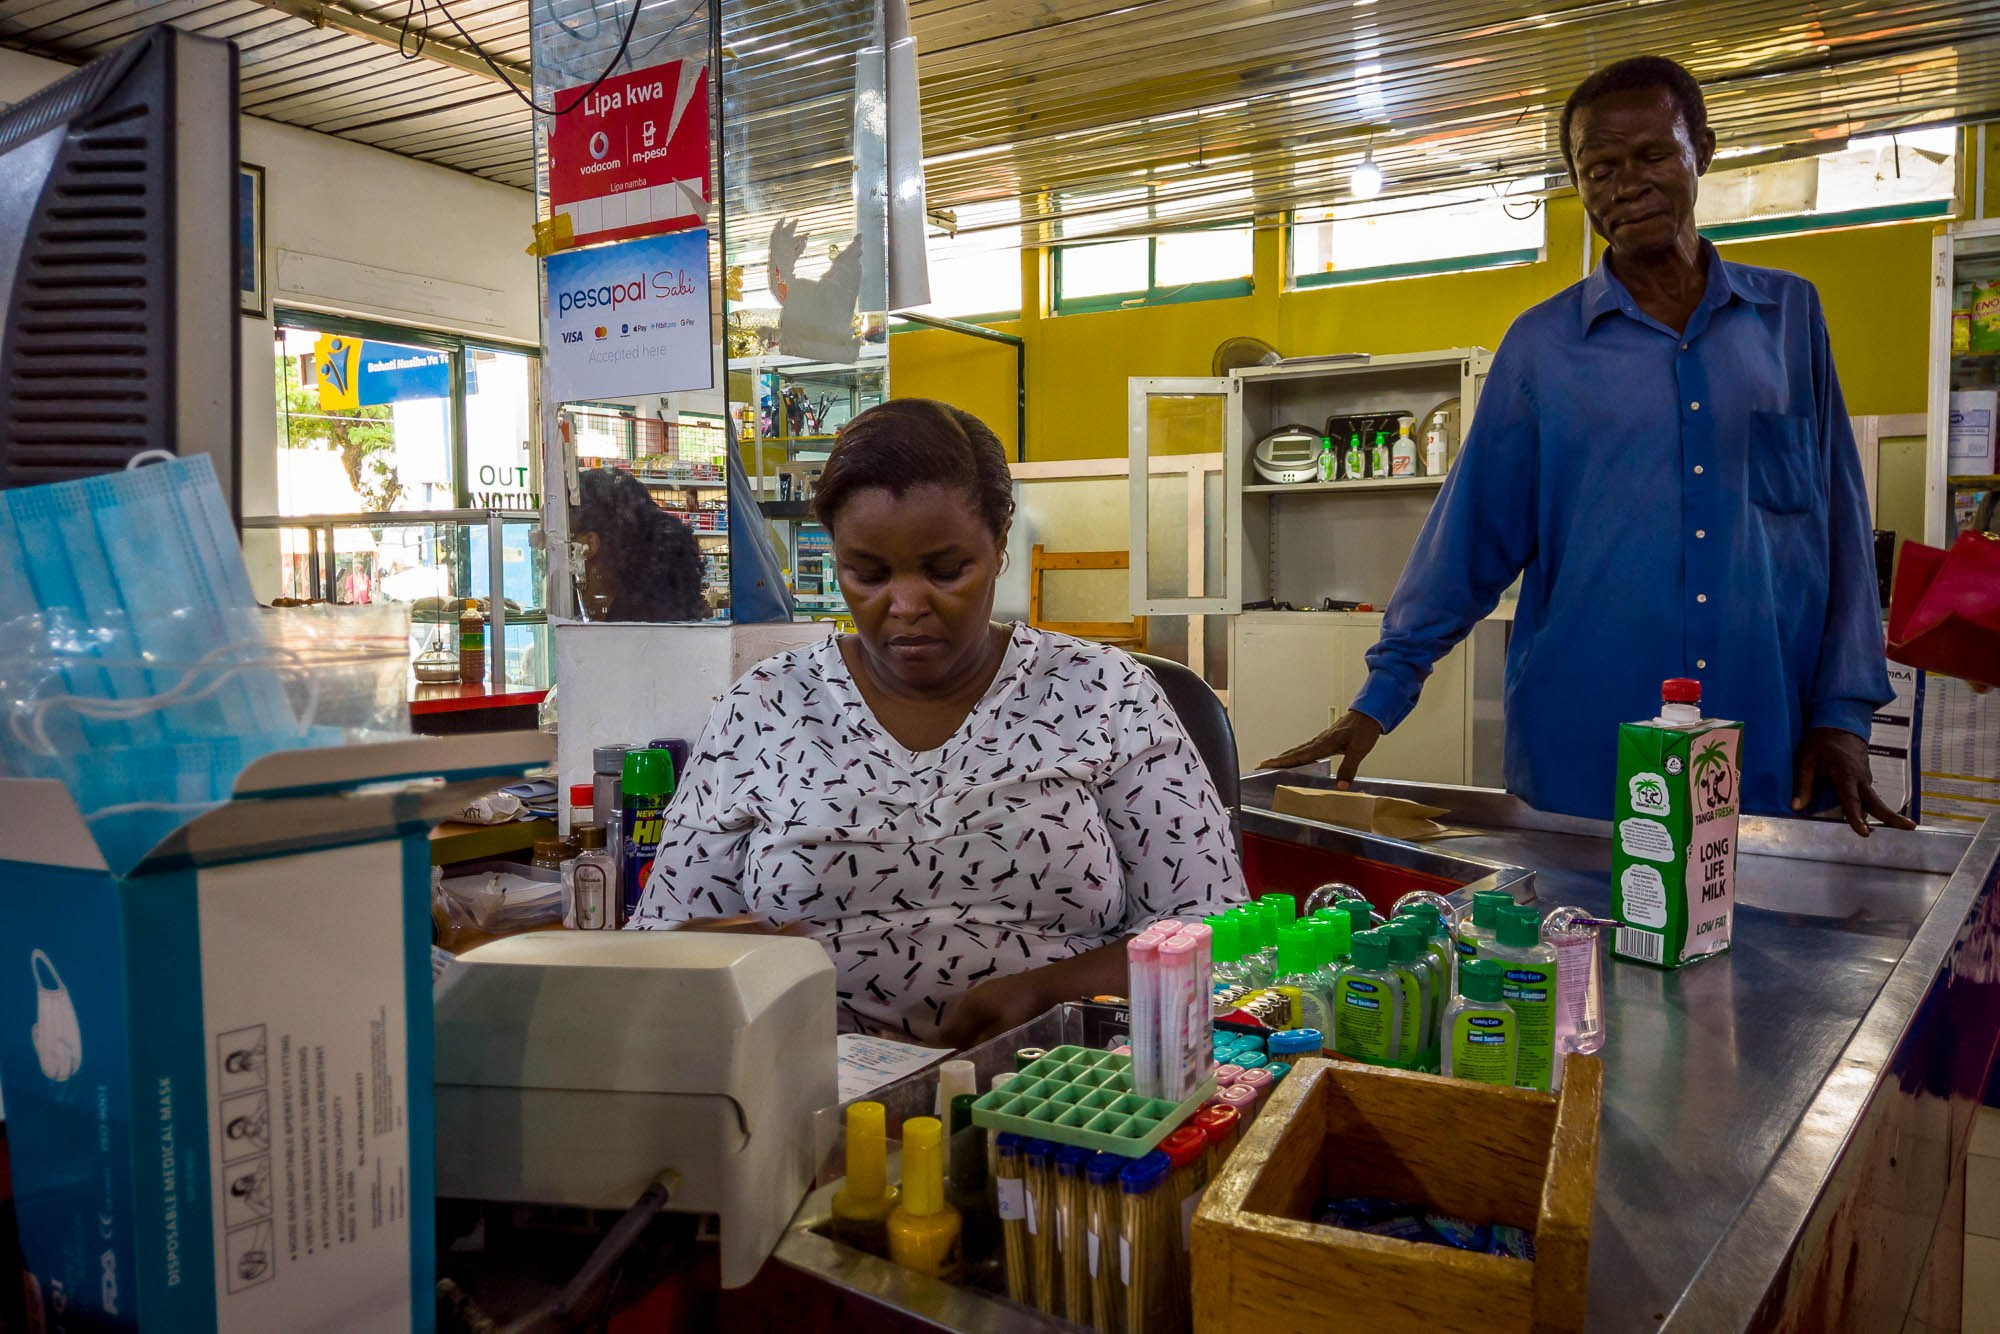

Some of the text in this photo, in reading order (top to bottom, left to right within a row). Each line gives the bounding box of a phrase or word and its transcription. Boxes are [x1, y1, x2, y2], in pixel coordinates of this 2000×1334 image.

[584, 81, 663, 117] Lipa kwa
[632, 146, 667, 164] m-pesa
[580, 159, 621, 175] vodacom
[610, 178, 647, 193] Lipa namba
[559, 269, 696, 319] pesapal Sabi
[1975, 297, 2000, 312] ENO
[561, 331, 584, 343] VISA
[588, 344, 667, 364] Accepted here
[636, 810, 655, 818] NEW
[1695, 805, 1735, 826] TANGA FRESH
[1700, 838, 1729, 863] LONG
[1704, 860, 1725, 882] LIFE
[1701, 879, 1726, 903] MILK
[1696, 914, 1727, 936] LOW FAT
[159, 1077, 182, 1286] DISPOSABLE MEDICAL MASK
